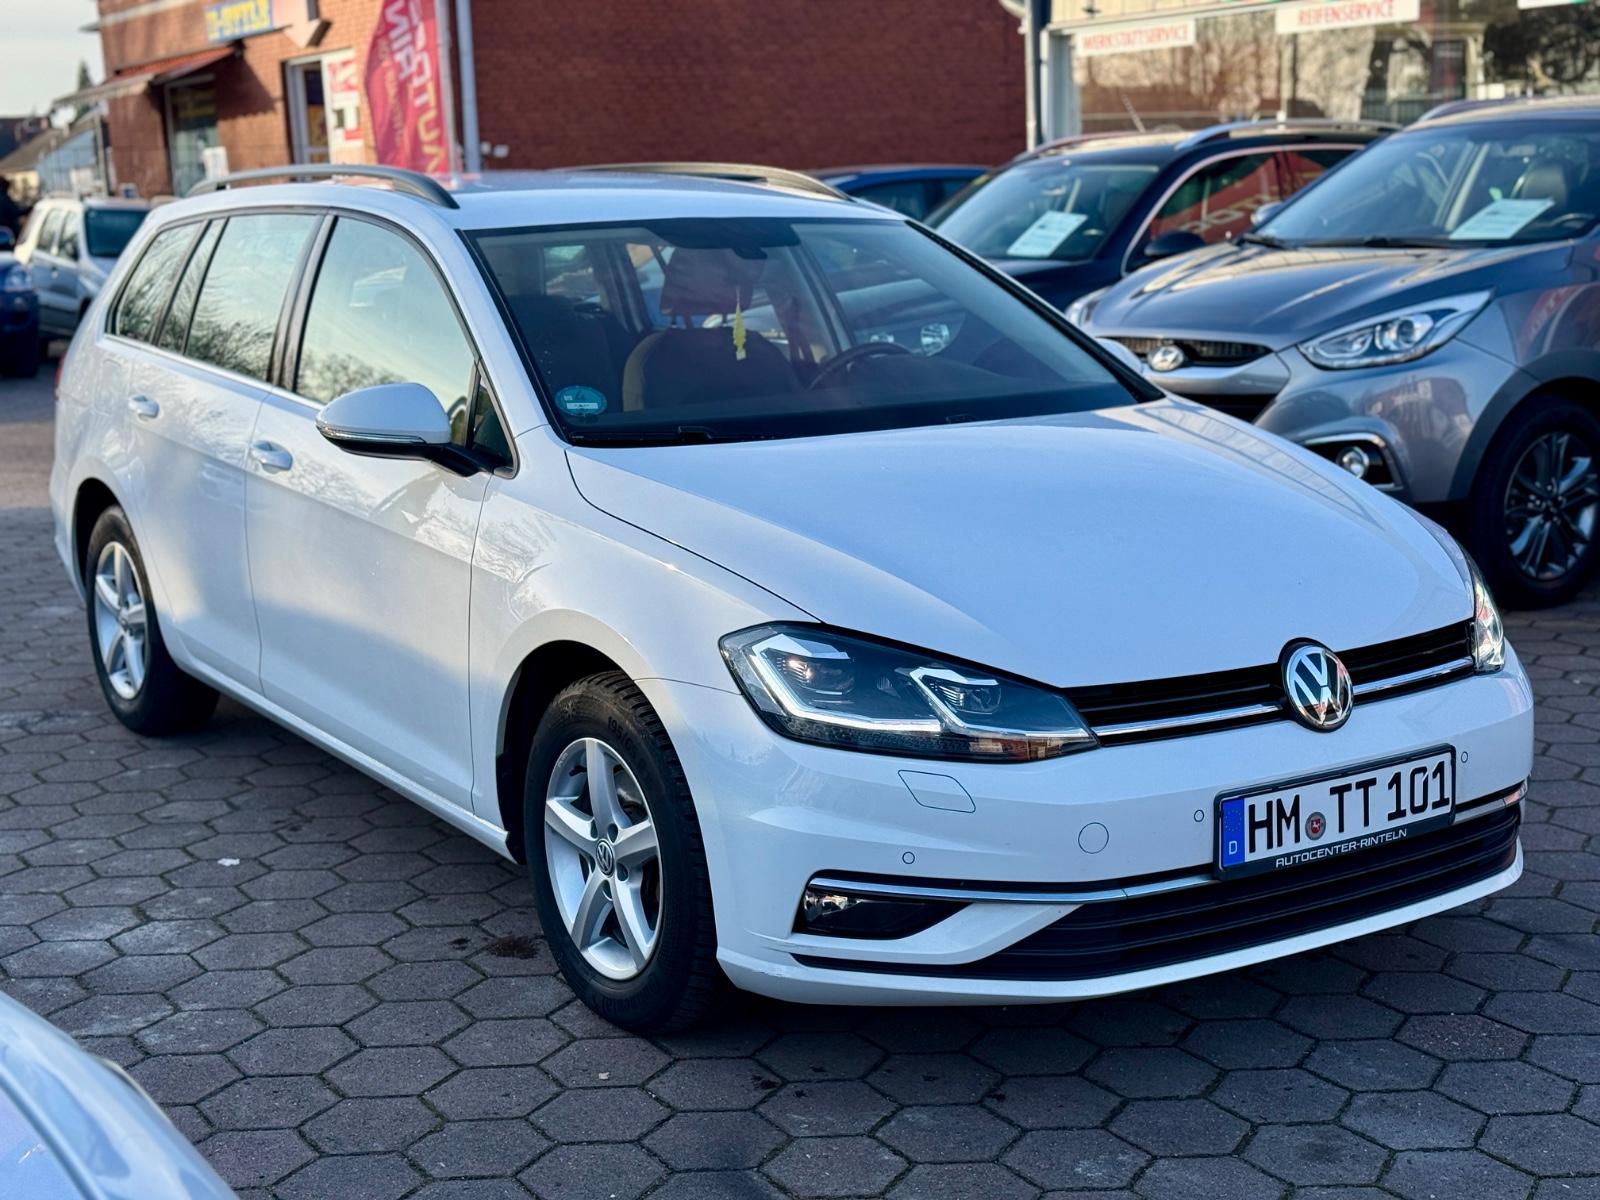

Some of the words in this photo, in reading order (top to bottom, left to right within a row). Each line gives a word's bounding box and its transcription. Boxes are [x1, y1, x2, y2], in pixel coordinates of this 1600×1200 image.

[1299, 0, 1394, 26] REIFENSERVICE
[1227, 839, 1239, 856] D
[1248, 794, 1301, 853] HM
[1329, 777, 1377, 833] TT
[1387, 760, 1450, 821] 101
[1275, 827, 1408, 869] AUTOCENTER-RINTELN
